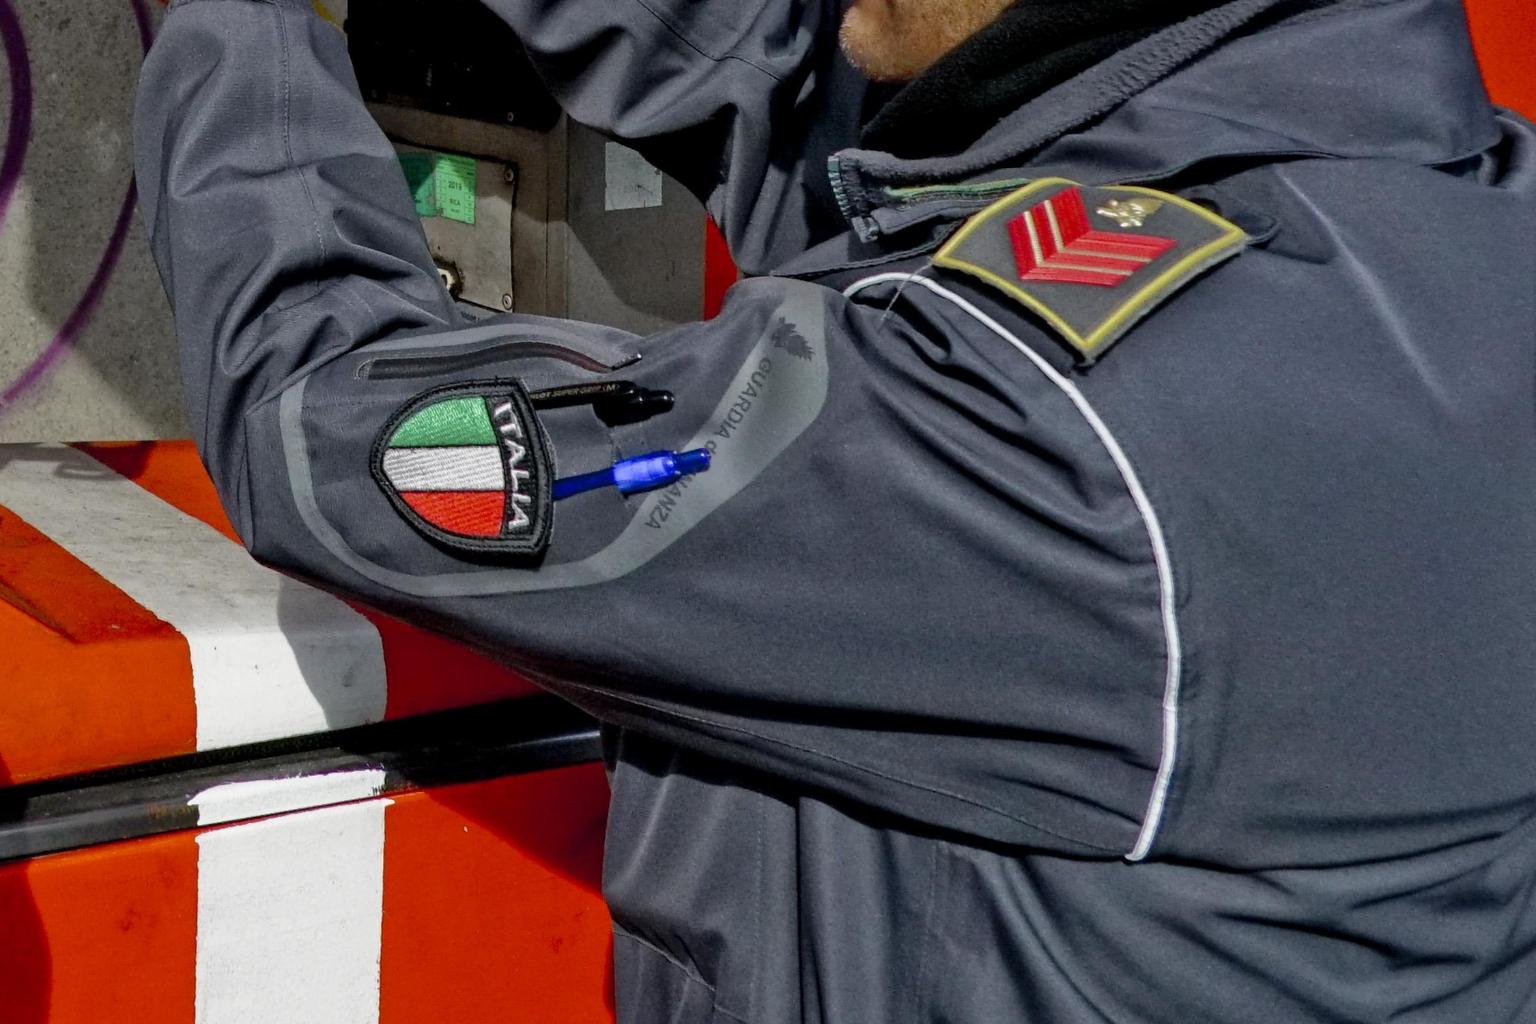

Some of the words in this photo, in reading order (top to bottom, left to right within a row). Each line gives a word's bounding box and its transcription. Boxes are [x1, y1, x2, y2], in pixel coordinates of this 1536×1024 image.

[714, 357, 772, 439] GUARDIA
[494, 402, 532, 529] ITALIA
[645, 472, 696, 529] NANZA
